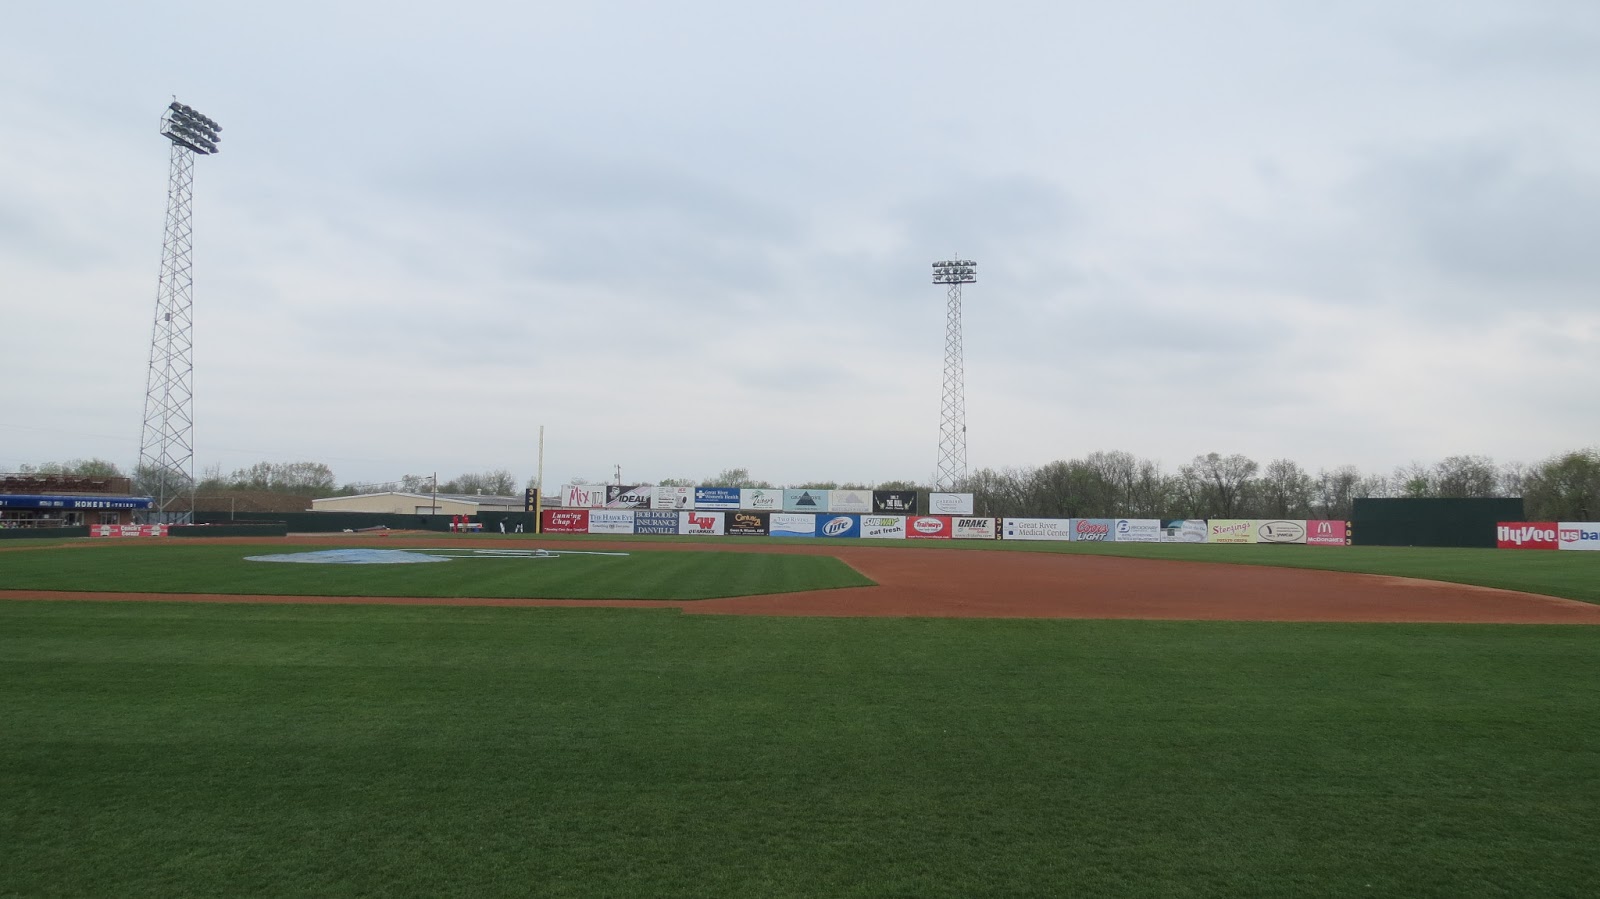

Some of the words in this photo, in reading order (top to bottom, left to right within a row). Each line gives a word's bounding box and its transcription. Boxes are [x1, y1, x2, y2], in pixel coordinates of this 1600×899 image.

[569, 486, 589, 506] Mix
[618, 495, 647, 503] IDEAL
[635, 511, 650, 519] BOB
[651, 511, 679, 519] DODDS
[636, 518, 678, 527] INSURANCE
[864, 517, 900, 527] SUBWAY
[957, 519, 989, 528] DRAKE
[1018, 522, 1038, 530] Great
[1039, 522, 1058, 530] River
[1076, 520, 1109, 533] Coors
[828, 521, 848, 534] Lite
[1077, 533, 1107, 541] LIGHT
